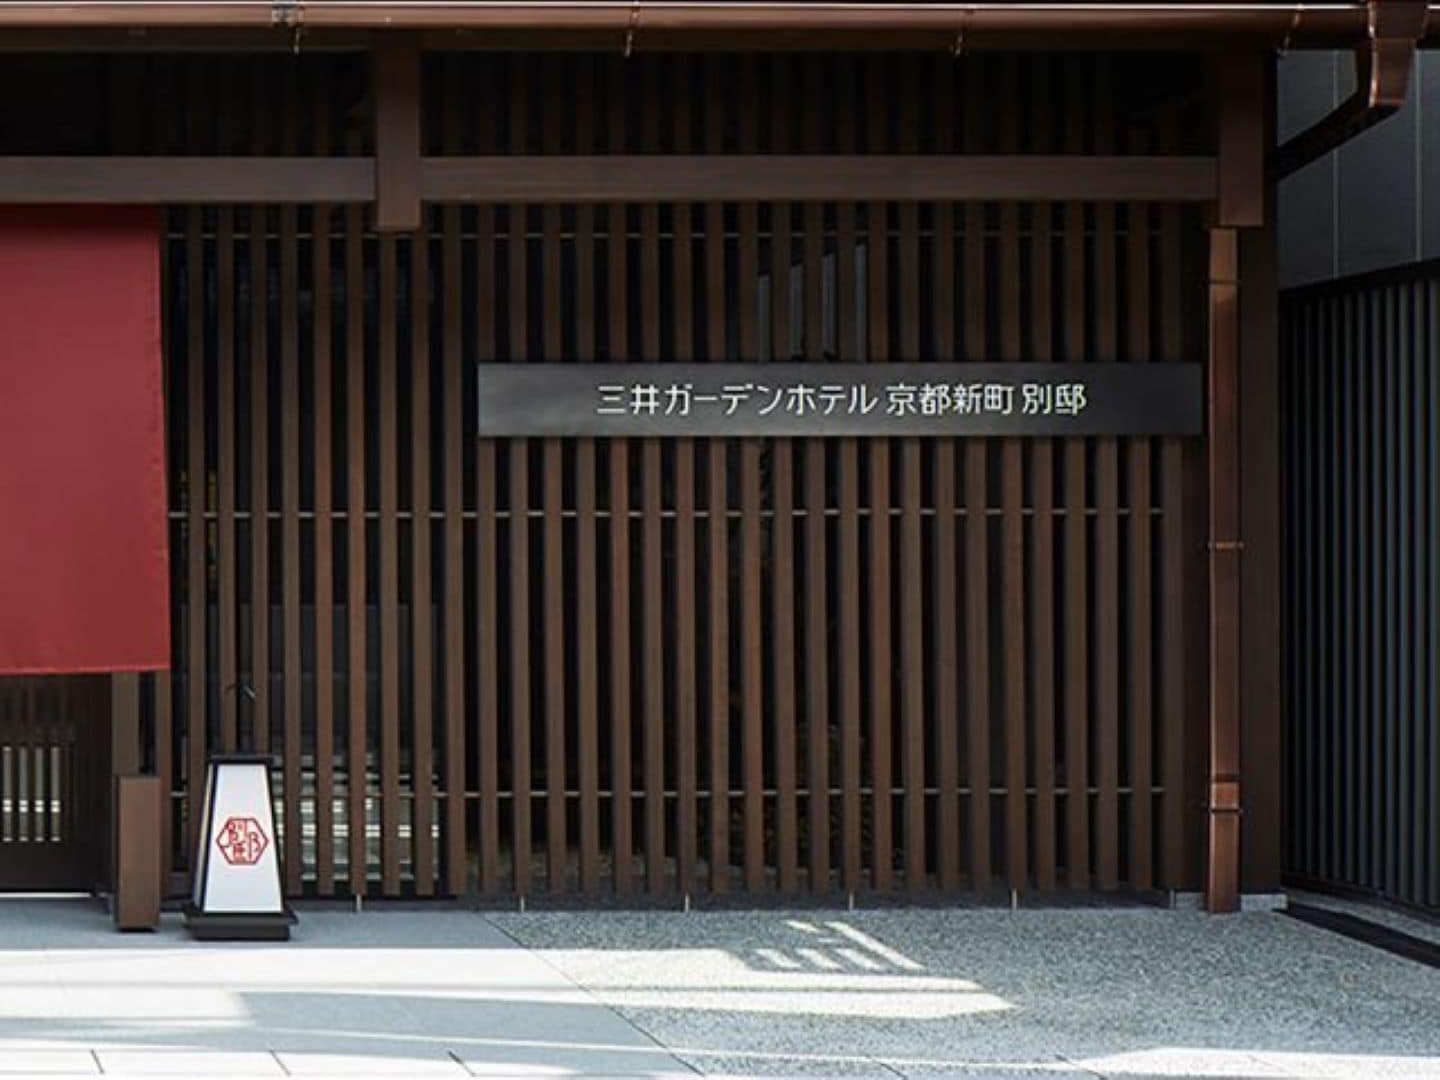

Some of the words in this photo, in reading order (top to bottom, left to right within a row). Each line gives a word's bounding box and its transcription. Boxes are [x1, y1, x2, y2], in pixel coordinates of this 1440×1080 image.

[596, 383, 878, 416] 三井ガーデンホテル
[885, 383, 1015, 416] 京都新町
[1021, 383, 1087, 415] 別邸
